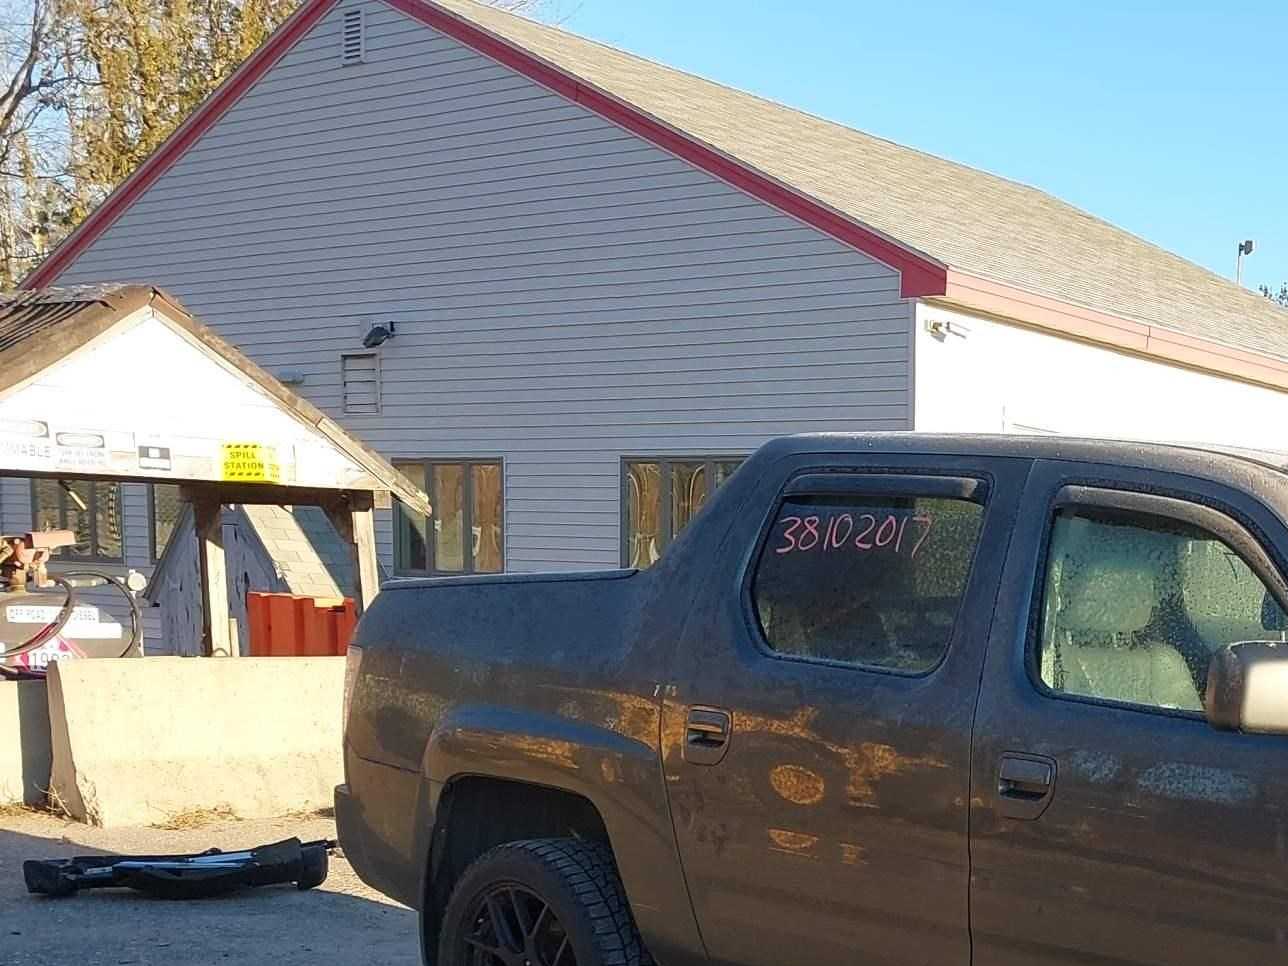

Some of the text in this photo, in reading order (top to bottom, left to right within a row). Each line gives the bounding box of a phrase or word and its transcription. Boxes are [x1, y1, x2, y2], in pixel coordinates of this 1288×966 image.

[230, 451, 256, 459] SPILL
[224, 462, 264, 470] STATION
[776, 514, 934, 559] 38102017
